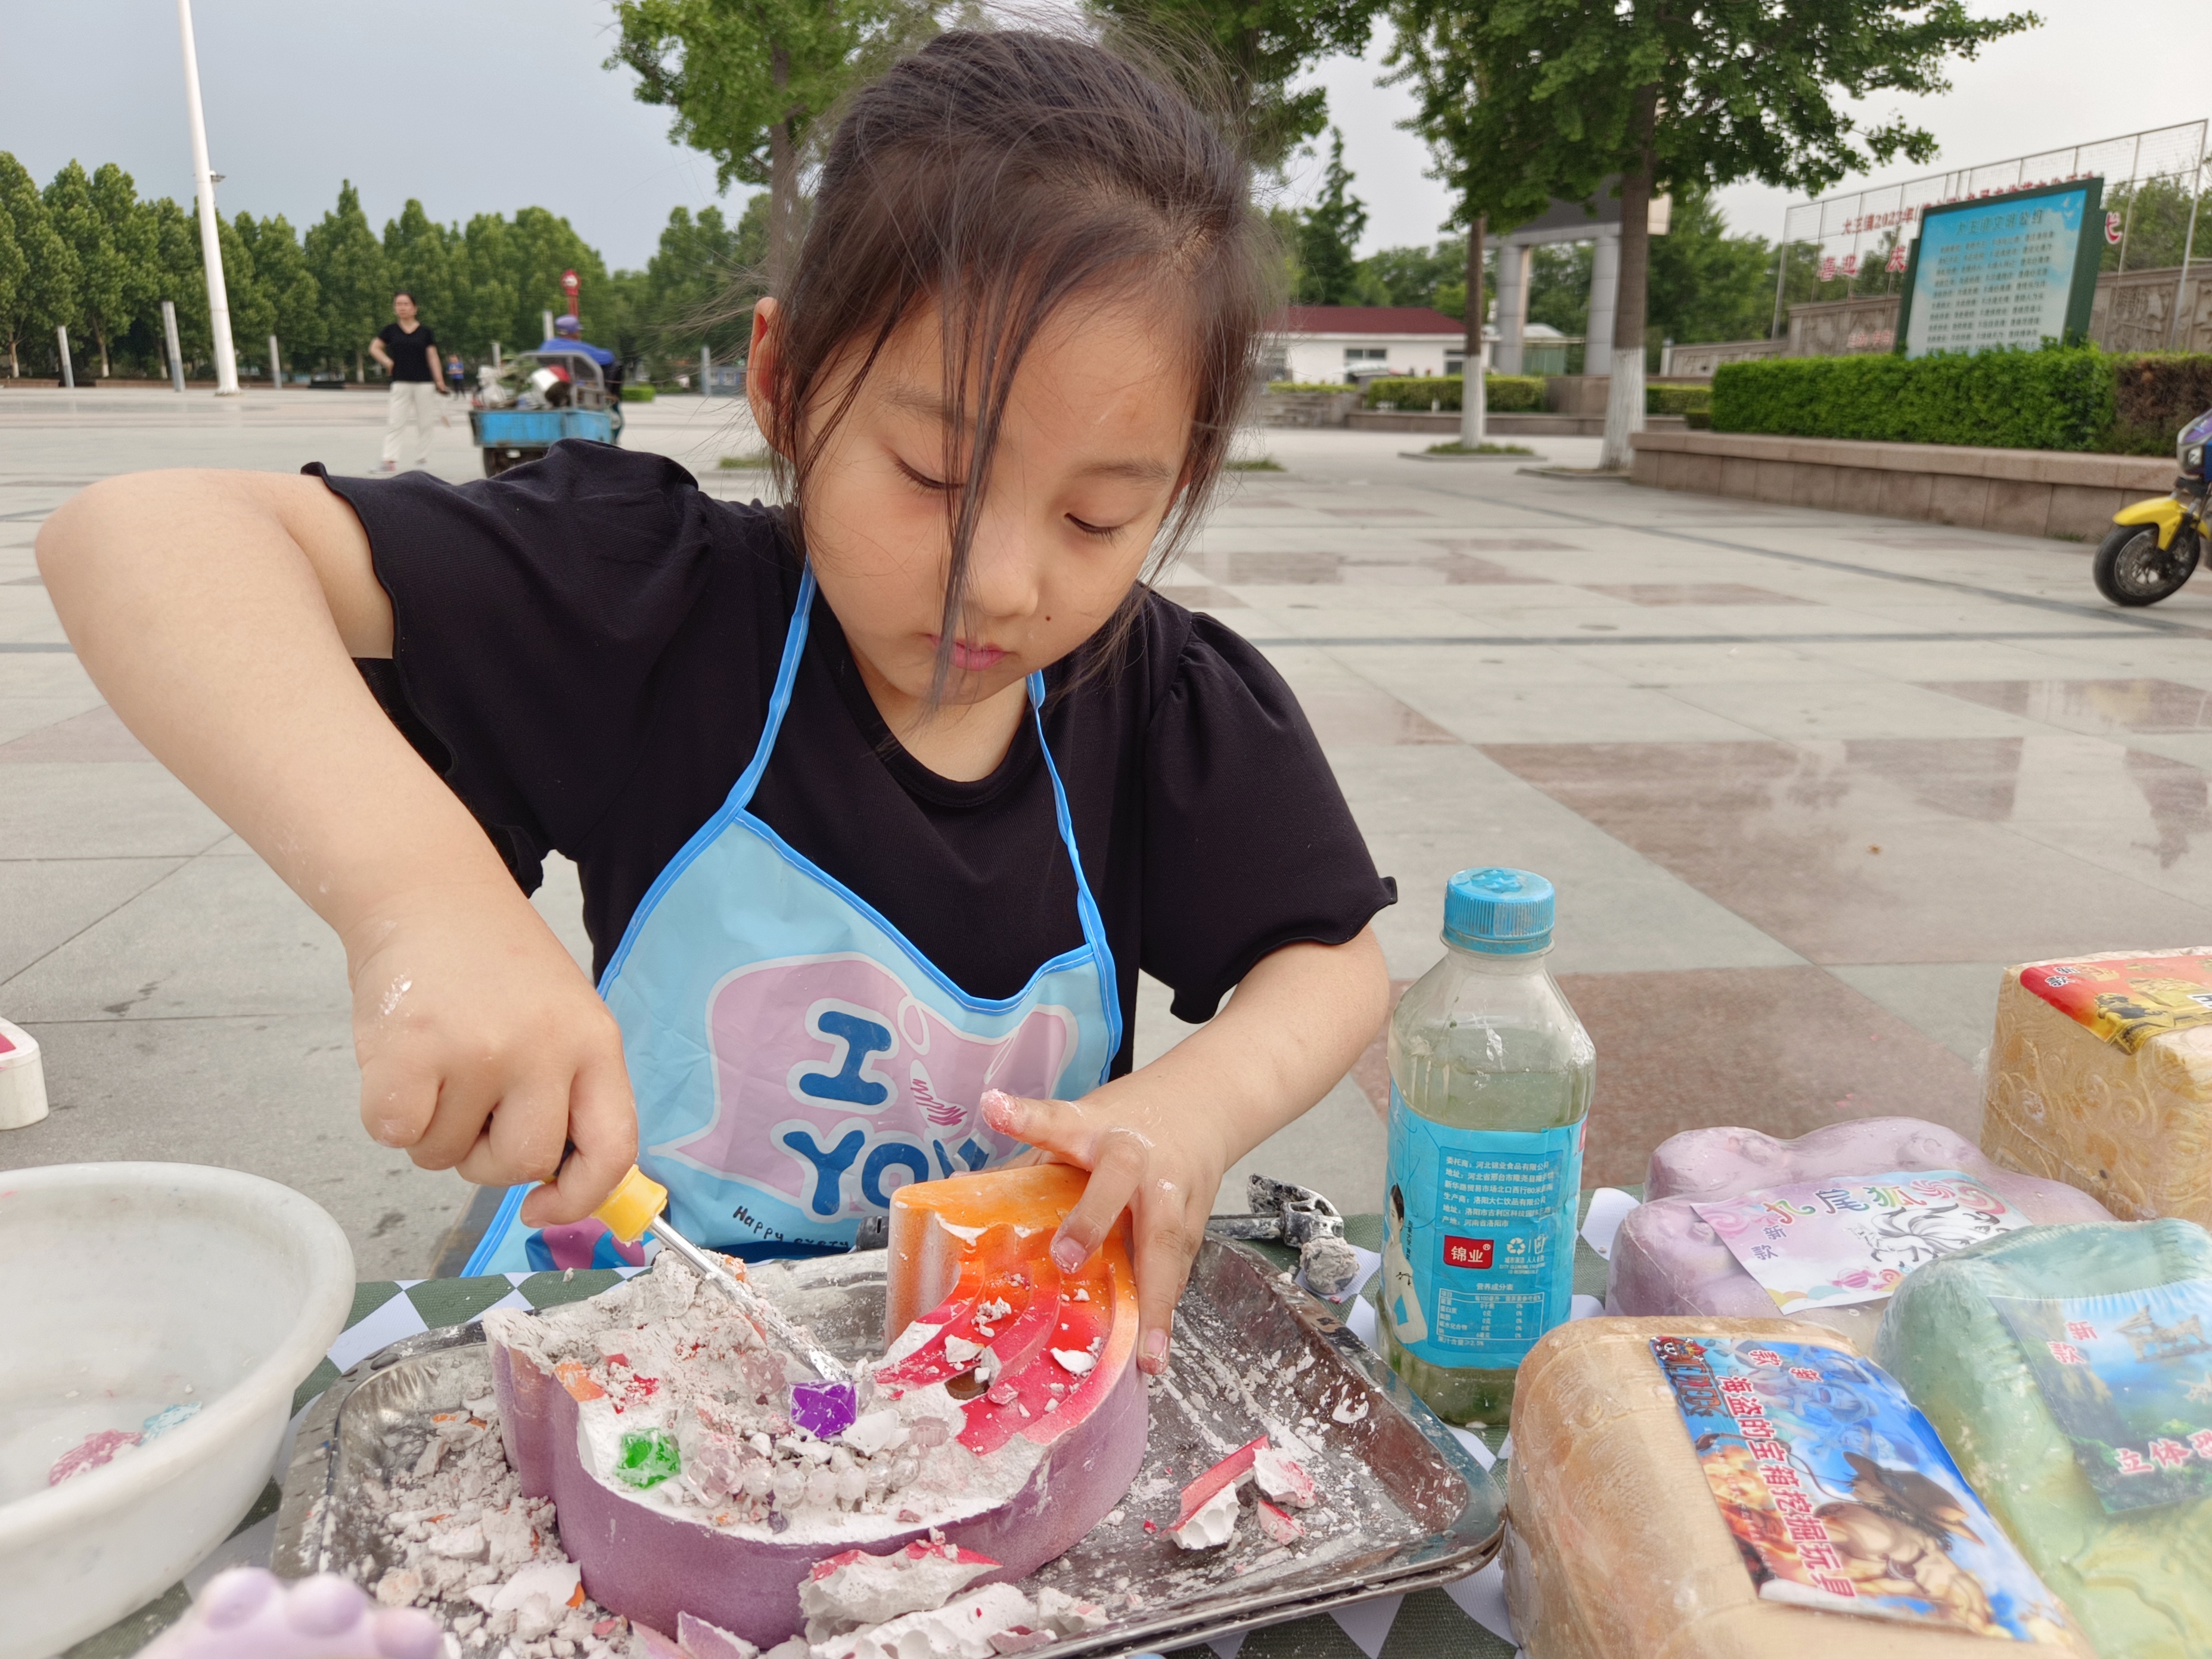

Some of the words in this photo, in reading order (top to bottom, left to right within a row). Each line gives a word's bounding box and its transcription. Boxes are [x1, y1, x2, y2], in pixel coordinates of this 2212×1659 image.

[799, 1011, 892, 1105] I
[733, 1206, 784, 1242] Happy
[1763, 1186, 1927, 1225] 九尾狐
[1451, 1246, 1483, 1262] 锦业
